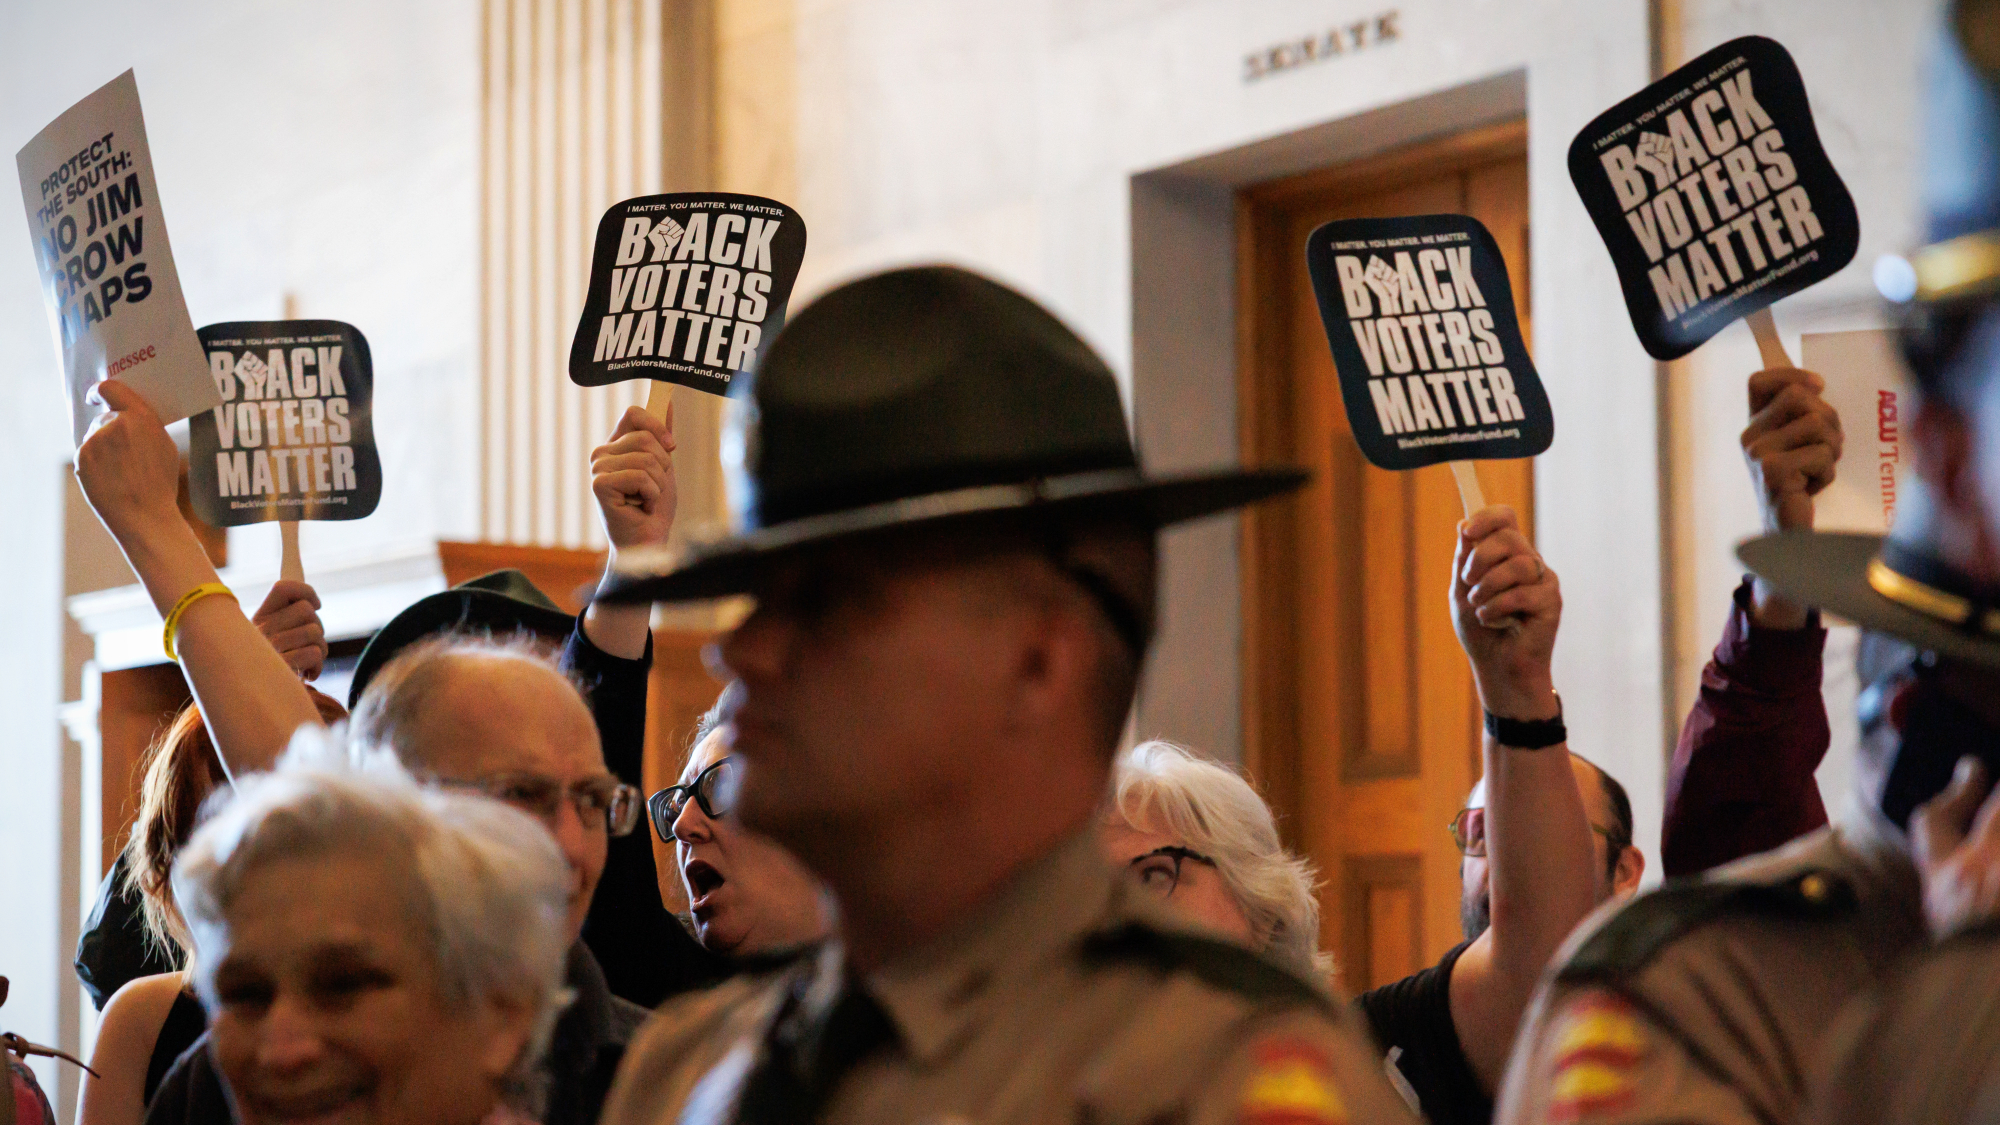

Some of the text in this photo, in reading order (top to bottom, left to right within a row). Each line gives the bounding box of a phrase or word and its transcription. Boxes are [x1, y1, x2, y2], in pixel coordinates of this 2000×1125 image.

[36, 150, 133, 229] THE SOUTH:
[40, 132, 114, 200] PROTECT
[1625, 128, 1798, 264] VOTERS
[40, 171, 143, 272] NO JIM
[632, 204, 667, 212] MATTER.
[670, 202, 689, 210] YOU
[746, 205, 785, 217] MATTER.
[1336, 241, 1368, 250] MATTER.
[1368, 239, 1386, 248] YOU
[1387, 236, 1421, 247] MATTER.
[1435, 232, 1471, 243] MATTER.
[51, 215, 143, 308] CROW
[1647, 185, 1825, 322] MATTER
[61, 262, 153, 350] MAPS
[608, 263, 772, 322] VOTERS
[107, 345, 156, 377] nessee
[593, 309, 762, 372] MATTER
[607, 360, 731, 382] BlackVotersMatterFund.org
[1350, 308, 1505, 377] VOTERS
[213, 397, 351, 448] VOTERS
[1367, 367, 1526, 436] MATTER
[216, 446, 357, 497] MATTER
[1879, 446, 1899, 518] Tenne
